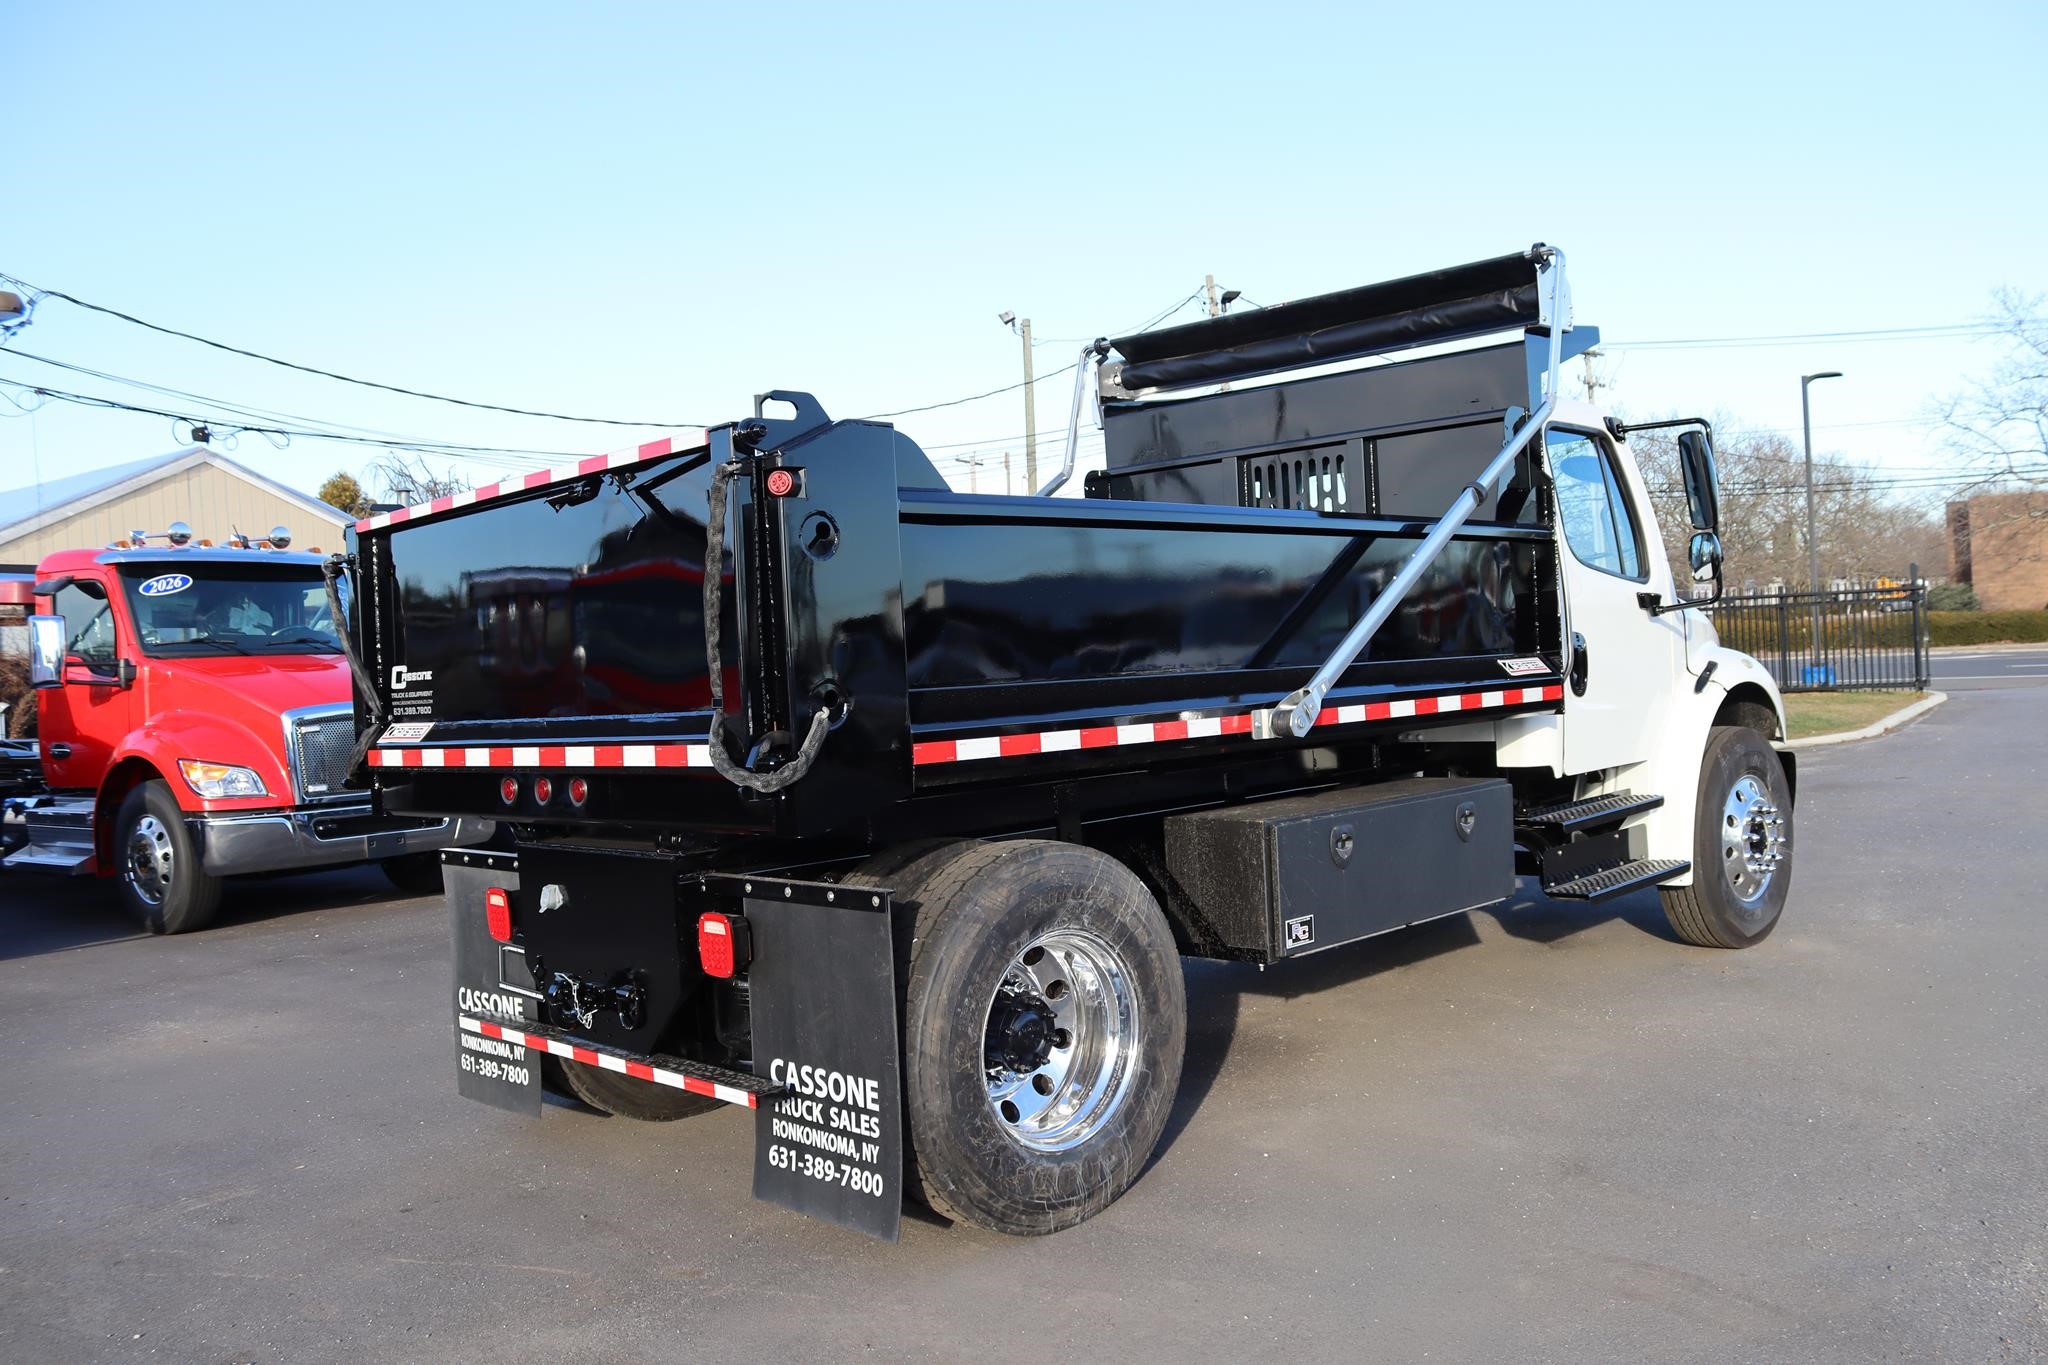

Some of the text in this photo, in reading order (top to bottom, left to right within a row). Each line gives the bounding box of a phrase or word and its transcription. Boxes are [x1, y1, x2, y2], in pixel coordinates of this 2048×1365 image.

[149, 576, 183, 594] 2026
[394, 706, 432, 715] 631.389.7800
[459, 987, 524, 1020] CASSONE
[461, 1033, 526, 1062] RONKONKOMA, NY
[460, 1053, 529, 1086] 631-389-7800
[769, 1058, 880, 1112] CASSONE
[829, 1106, 880, 1139] SALES
[772, 1118, 880, 1164] RONKONKOMA, NY
[768, 1144, 883, 1197] 631-389-7800
